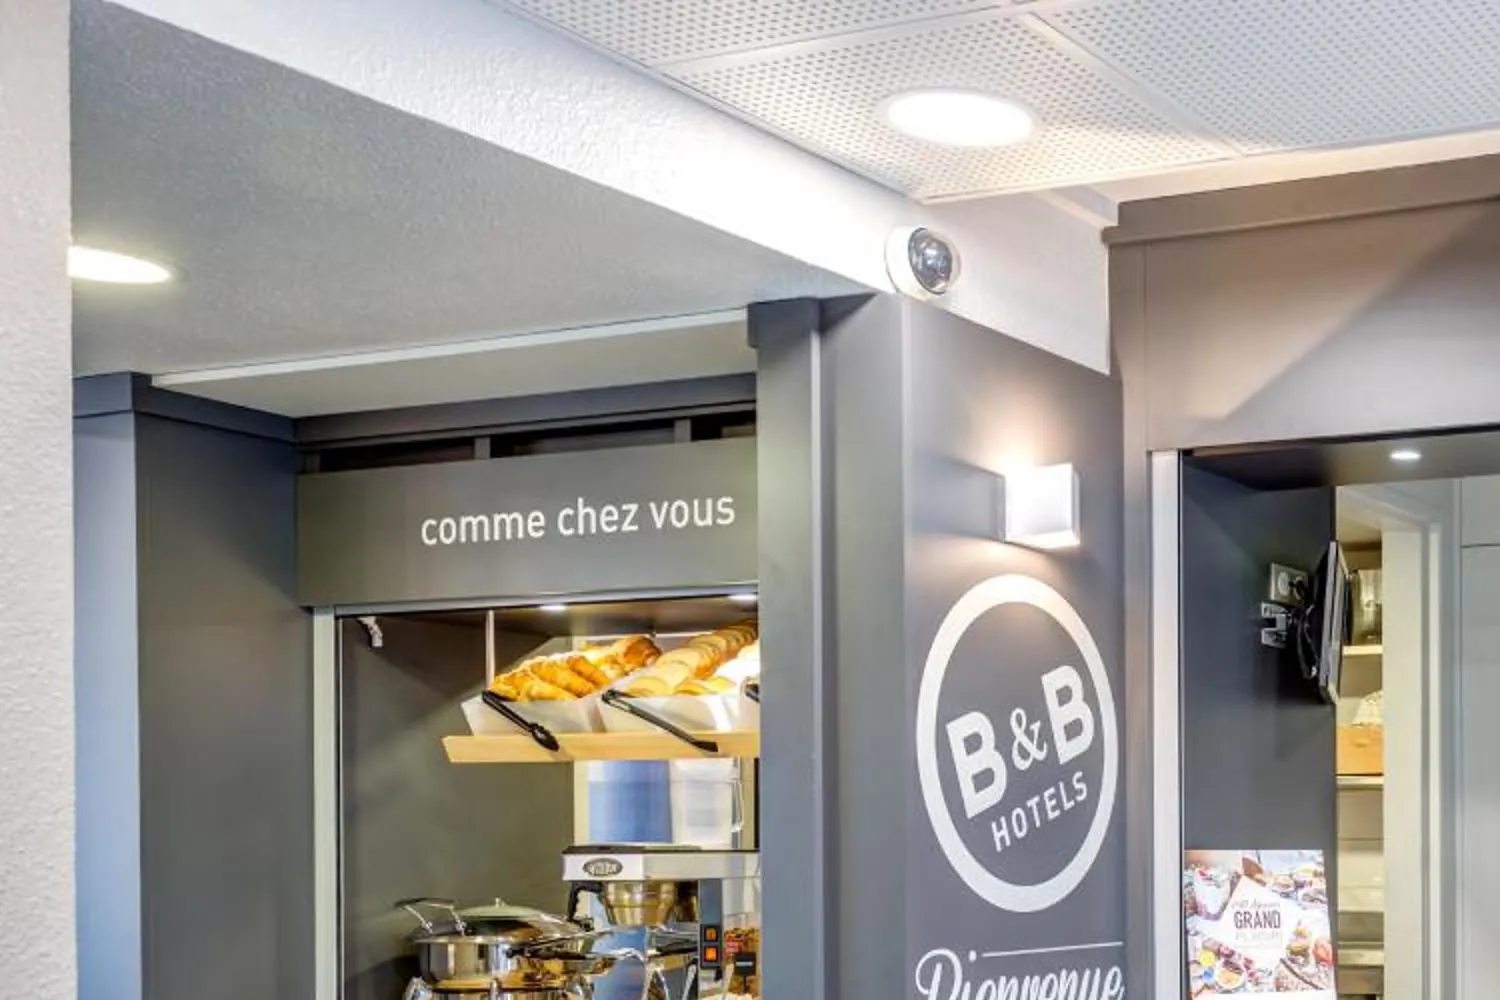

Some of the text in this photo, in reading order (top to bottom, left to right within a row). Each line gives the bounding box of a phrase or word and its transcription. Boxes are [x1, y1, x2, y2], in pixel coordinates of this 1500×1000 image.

[421, 495, 736, 546] comme chez vous
[946, 665, 1095, 819] B&B
[991, 771, 1088, 852] HOTELS
[1233, 910, 1281, 929] GRAND
